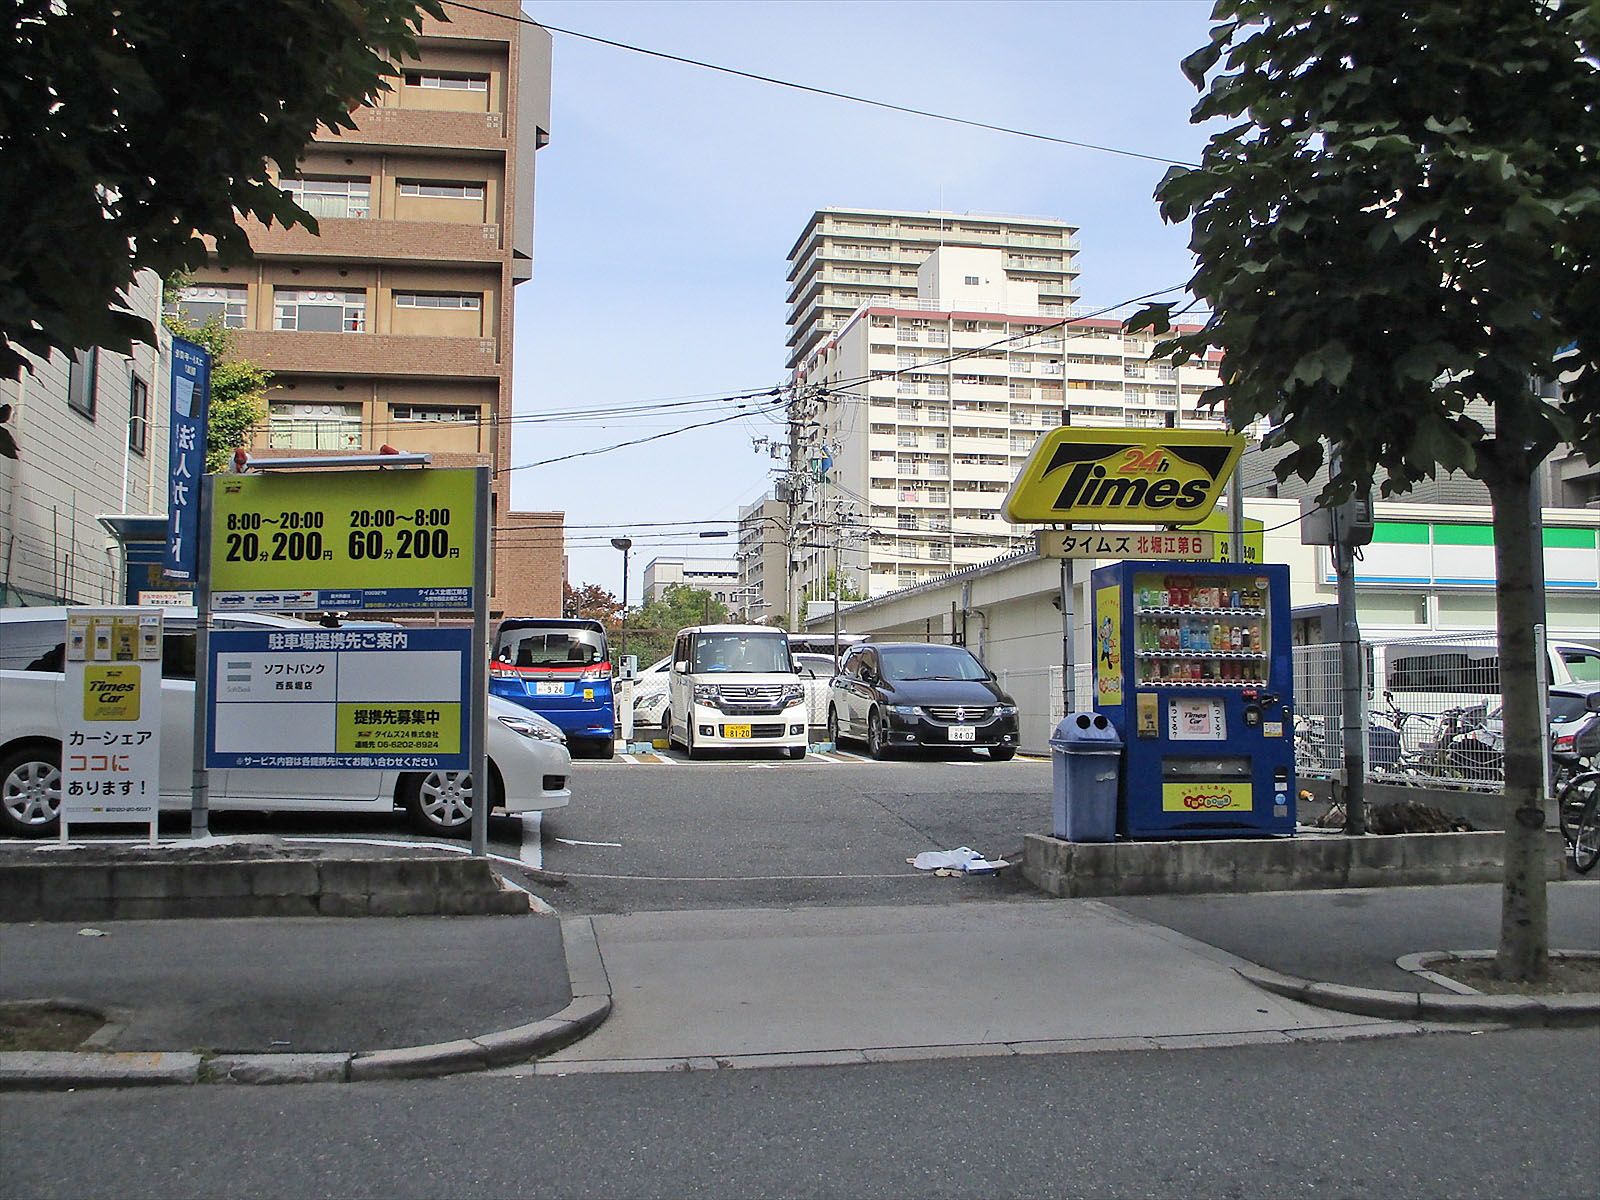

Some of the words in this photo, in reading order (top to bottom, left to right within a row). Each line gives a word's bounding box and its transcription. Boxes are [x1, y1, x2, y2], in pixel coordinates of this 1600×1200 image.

[1119, 450, 1169, 474] 24h
[1051, 462, 1211, 510] Times
[1061, 536, 1130, 554] タイムズ
[1137, 537, 1203, 555] 北堀江第6
[268, 632, 408, 651] 駐車場提携先ご案内
[264, 663, 325, 675] ソフトバンク
[89, 680, 135, 692] Times
[275, 681, 313, 690] 西長堀店
[98, 692, 126, 703] Car
[354, 709, 440, 725] 提携先募集中
[1184, 711, 1207, 719] Times
[69, 731, 152, 746] カーシェア
[70, 754, 130, 772] ココに
